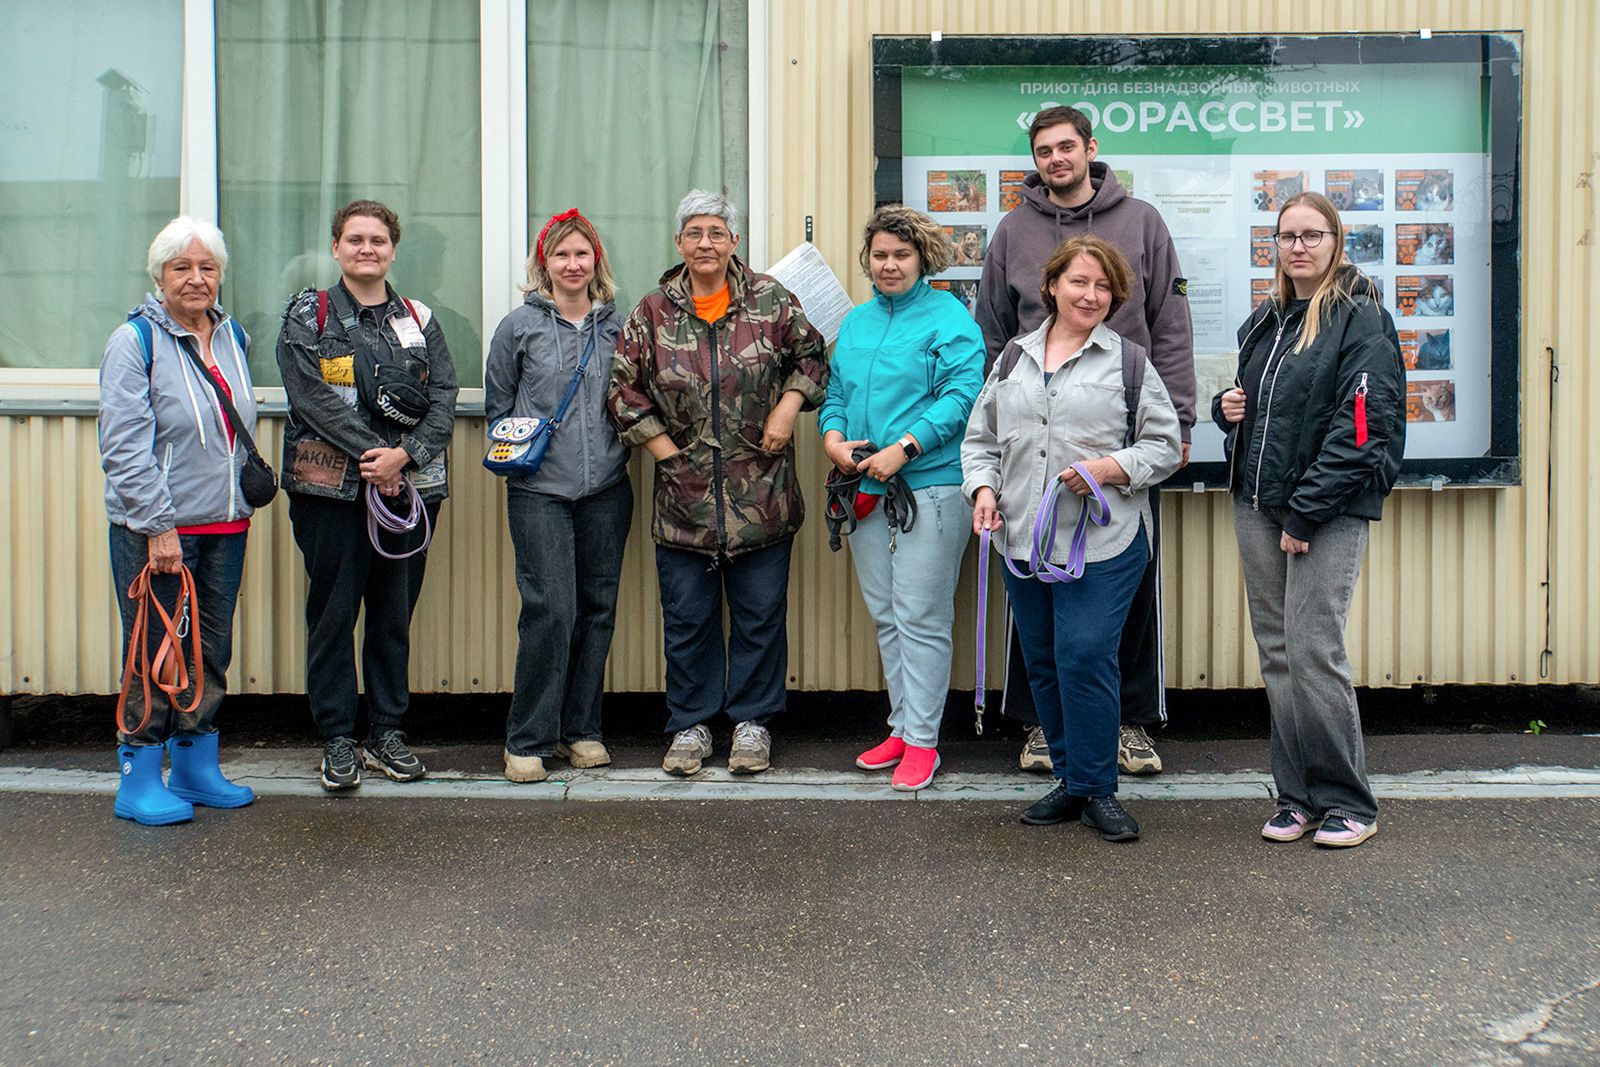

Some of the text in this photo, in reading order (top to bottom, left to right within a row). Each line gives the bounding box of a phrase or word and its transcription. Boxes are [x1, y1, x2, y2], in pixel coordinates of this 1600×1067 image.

[1020, 81, 1361, 96] ПРИЮТ ДЛЯ БЕЗНАДЗОРНЫХ ЖИВОТНЫХ
[1016, 101, 1365, 133] «ООРАССВЕТ»
[377, 394, 420, 426] Suprem
